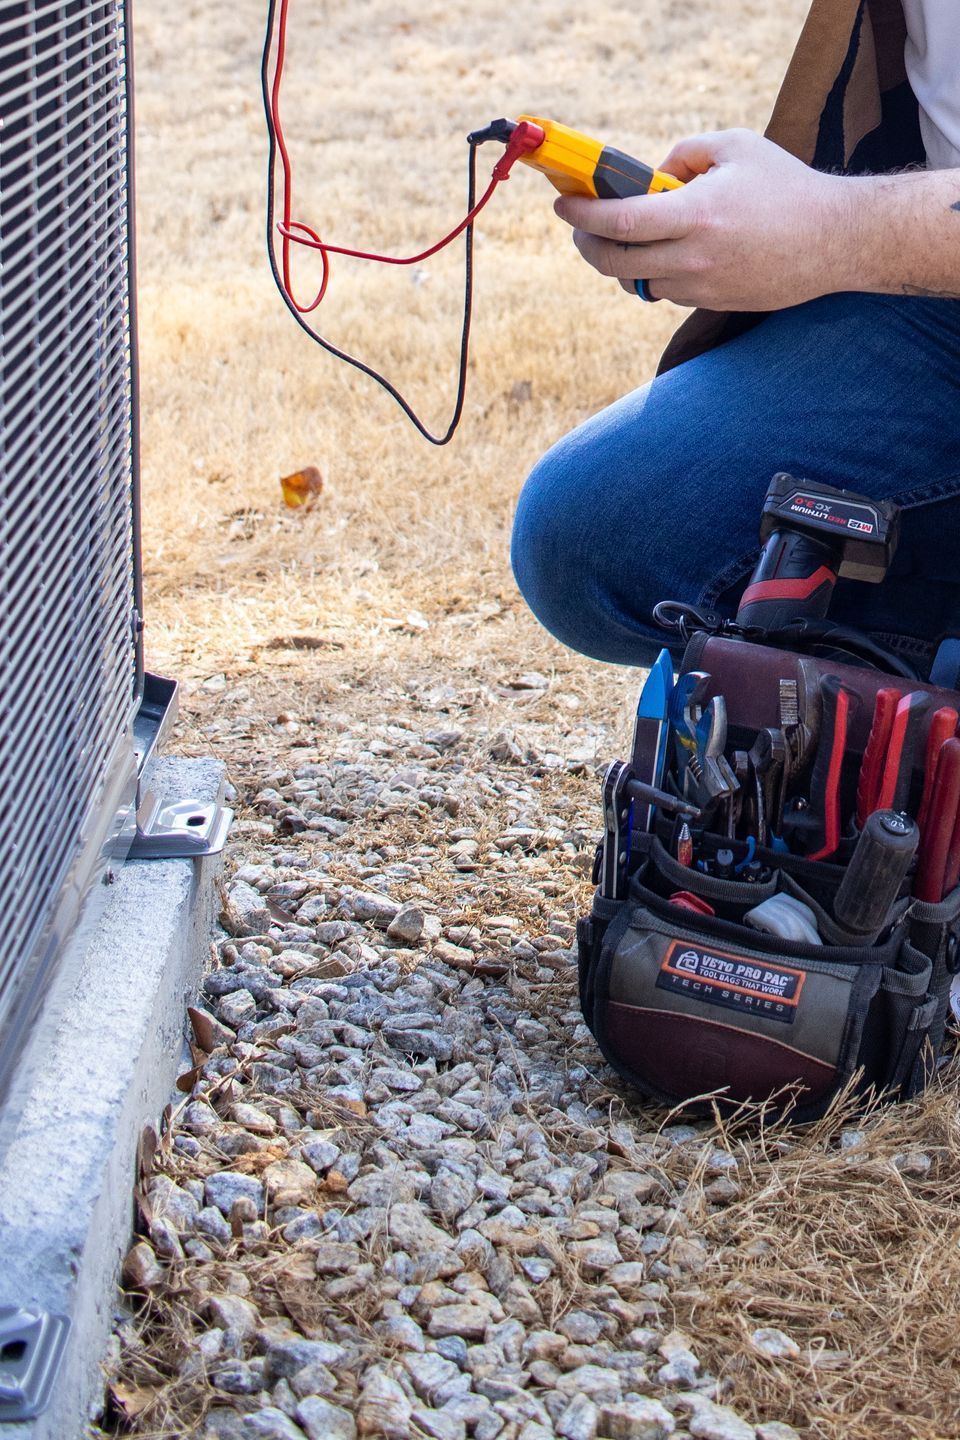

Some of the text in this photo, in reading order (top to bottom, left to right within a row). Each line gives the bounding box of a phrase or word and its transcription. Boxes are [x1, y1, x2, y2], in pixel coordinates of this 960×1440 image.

[849, 520, 872, 532] M12
[702, 955, 734, 973] VETO
[735, 964, 762, 980] PRO
[671, 975, 784, 1012] TECH SERIES
[700, 969, 785, 997] TOOL BAGS THAT WORK
